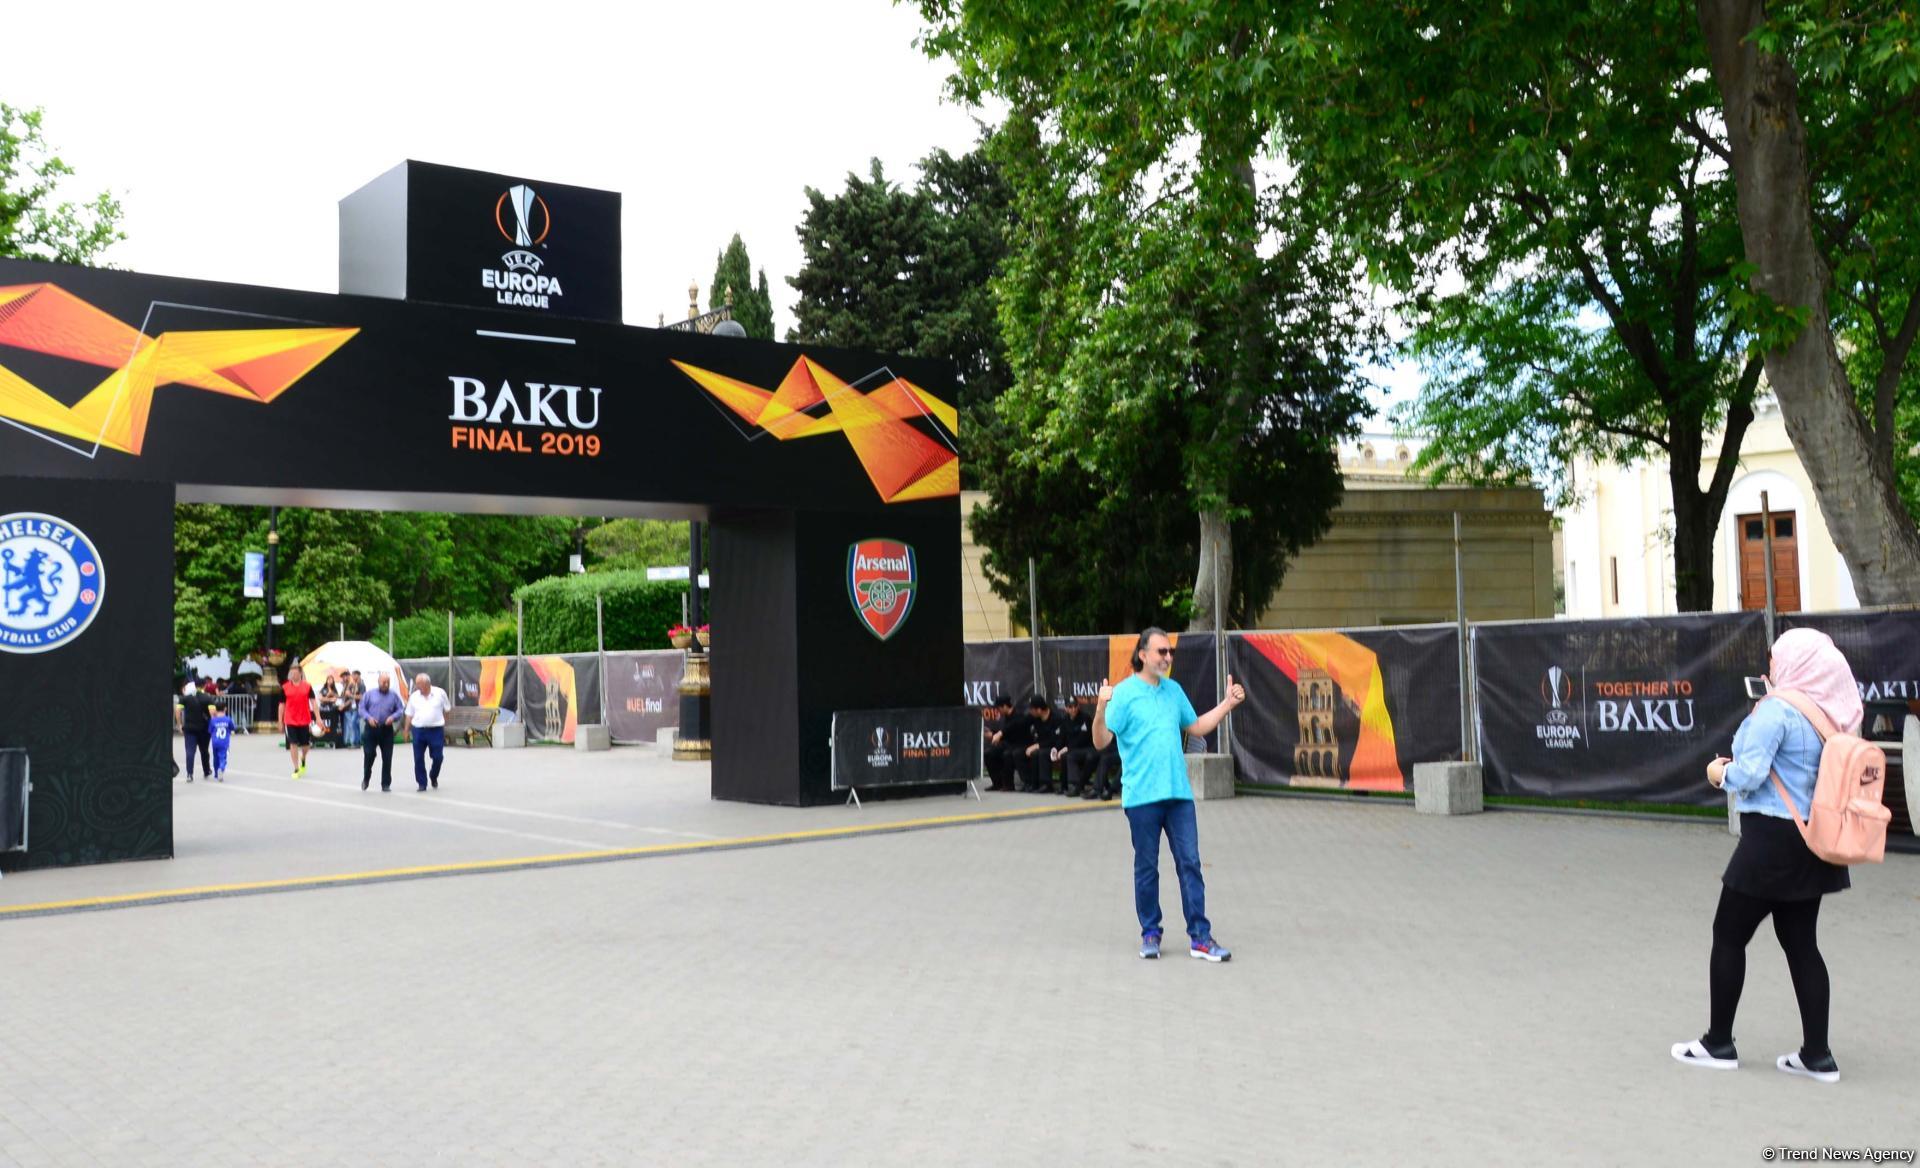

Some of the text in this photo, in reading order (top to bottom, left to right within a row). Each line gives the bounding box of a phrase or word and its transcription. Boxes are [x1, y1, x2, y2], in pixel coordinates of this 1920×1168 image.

[503, 252, 541, 272] UEFA
[482, 269, 563, 296] EUROPA
[496, 290, 549, 309] LEAGUE
[448, 376, 603, 430] BAKU
[452, 426, 601, 457] FINAL 2019
[0, 520, 76, 551] HELSEA
[857, 554, 906, 572] Arsenal
[46, 617, 77, 639] CLUB
[964, 681, 1000, 706] AKU
[1596, 680, 1693, 697] TOGETHER TO
[1597, 698, 1695, 732] BAKU
[903, 731, 950, 749] BAKU
[1536, 725, 1581, 739] EUROPA
[1545, 738, 1574, 749] LEAGUE
